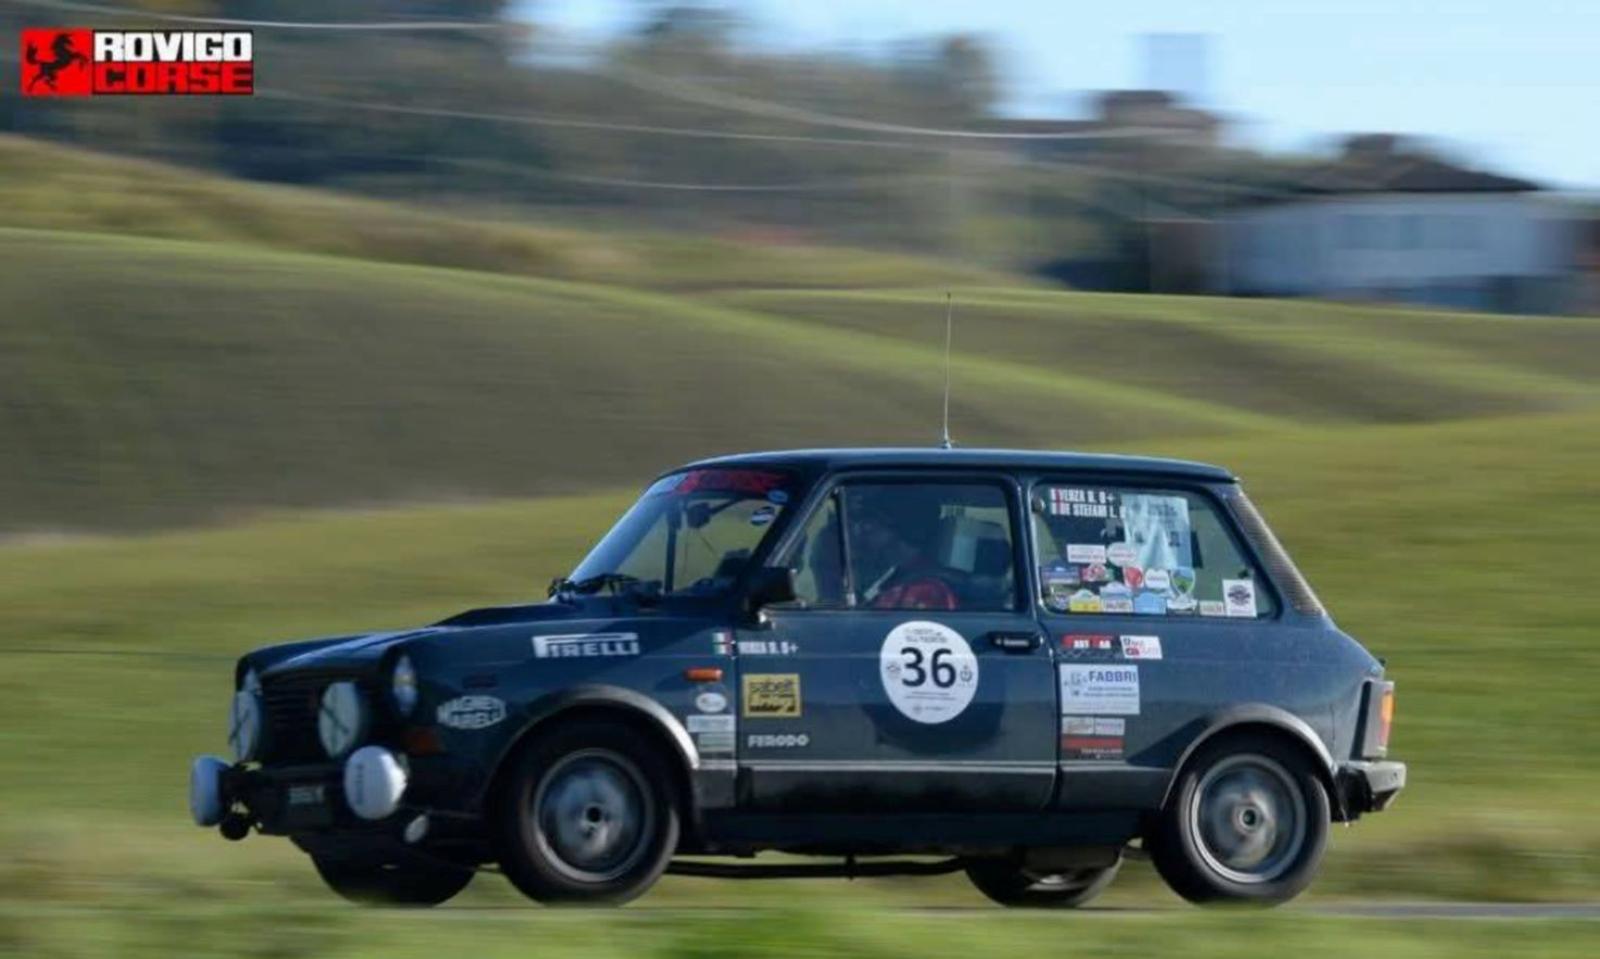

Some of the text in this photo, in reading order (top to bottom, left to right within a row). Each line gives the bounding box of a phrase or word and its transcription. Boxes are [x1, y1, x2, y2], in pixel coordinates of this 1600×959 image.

[532, 632, 640, 658] PIRELLI
[900, 646, 956, 688] 36
[1088, 669, 1137, 683] FABBRI
[747, 734, 809, 749] FERODO
